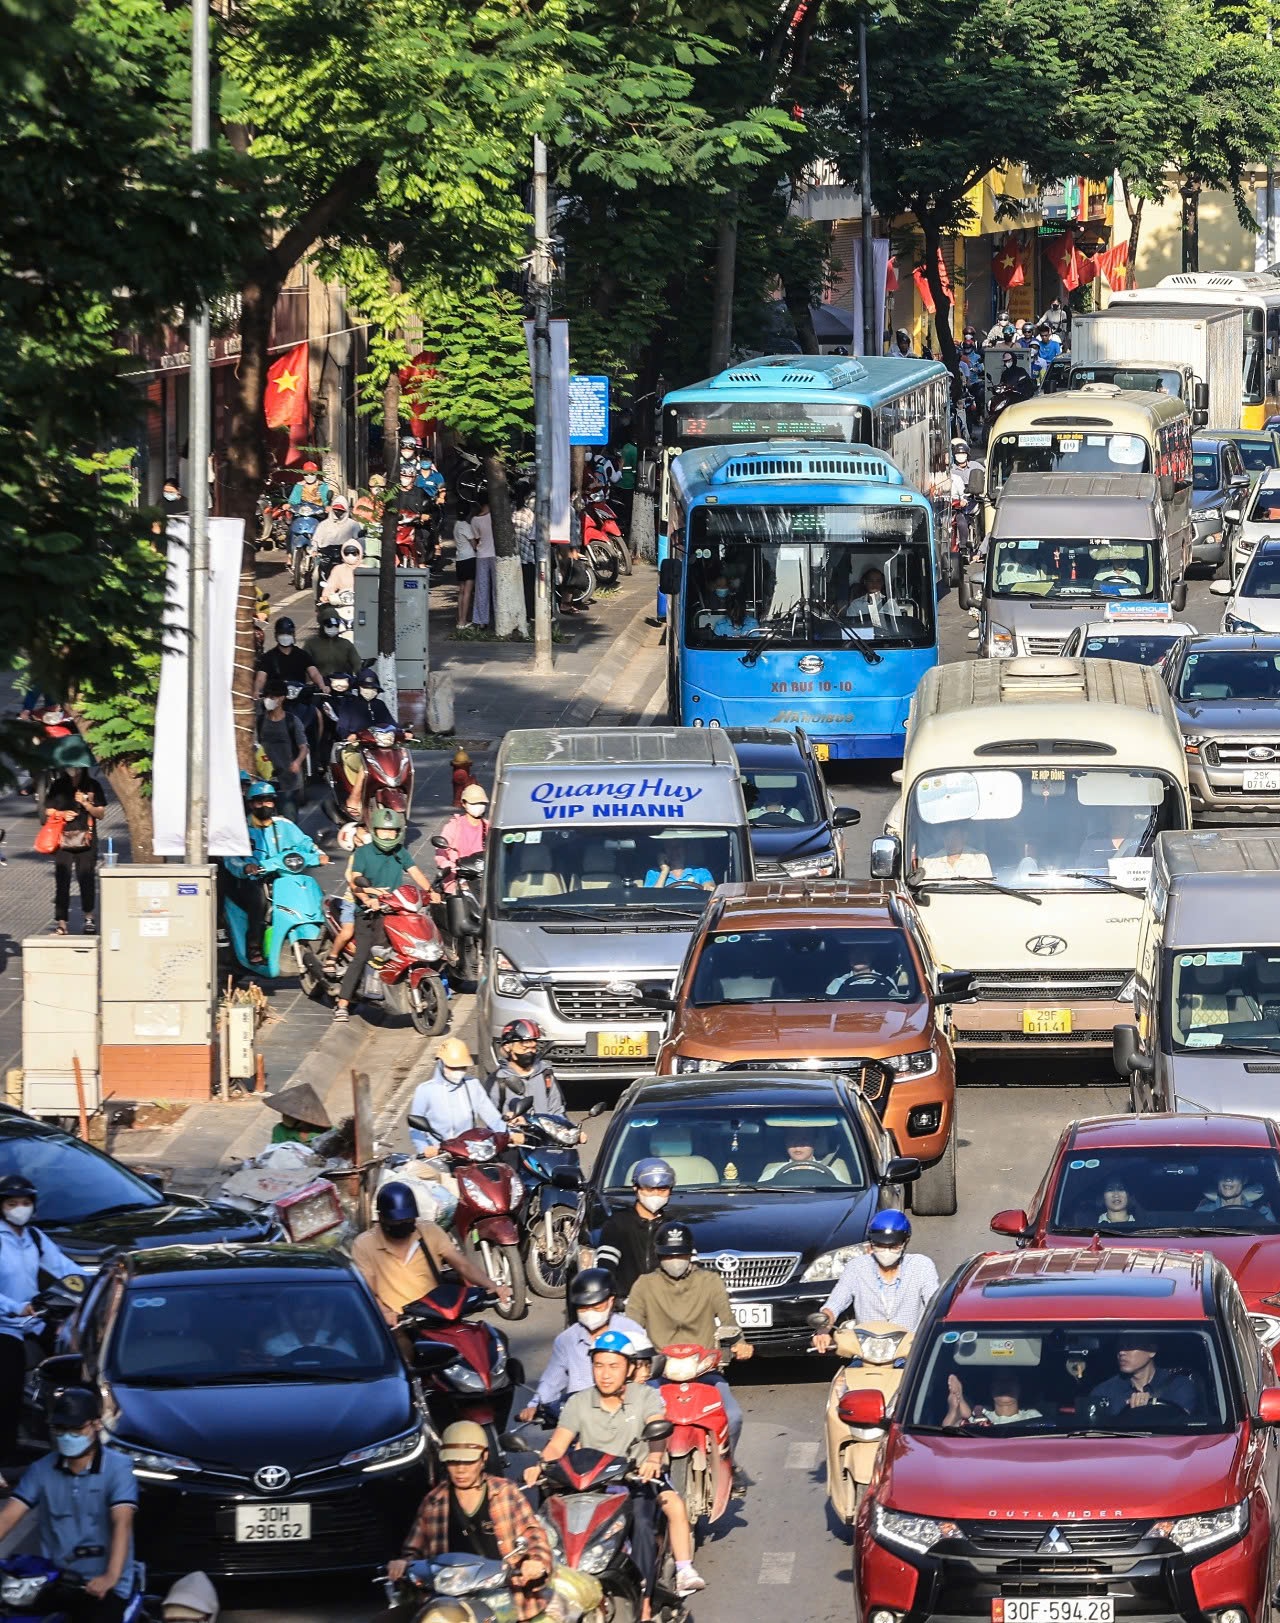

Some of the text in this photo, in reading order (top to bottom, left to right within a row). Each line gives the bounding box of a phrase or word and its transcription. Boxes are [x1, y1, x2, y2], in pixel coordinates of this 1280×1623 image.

[791, 681, 814, 692] BUS
[1247, 780, 1277, 789] 071.45
[543, 803, 685, 820] VIP NHANH
[1037, 1010, 1057, 1021] 29F
[1028, 1021, 1065, 1032] 011.41
[603, 1045, 642, 1056] 002.85
[257, 1506, 290, 1522] 30H
[988, 1510, 1123, 1518] OUTLANDER
[245, 1523, 303, 1540] 296.62
[1007, 1601, 1111, 1621] 30F-594.28
